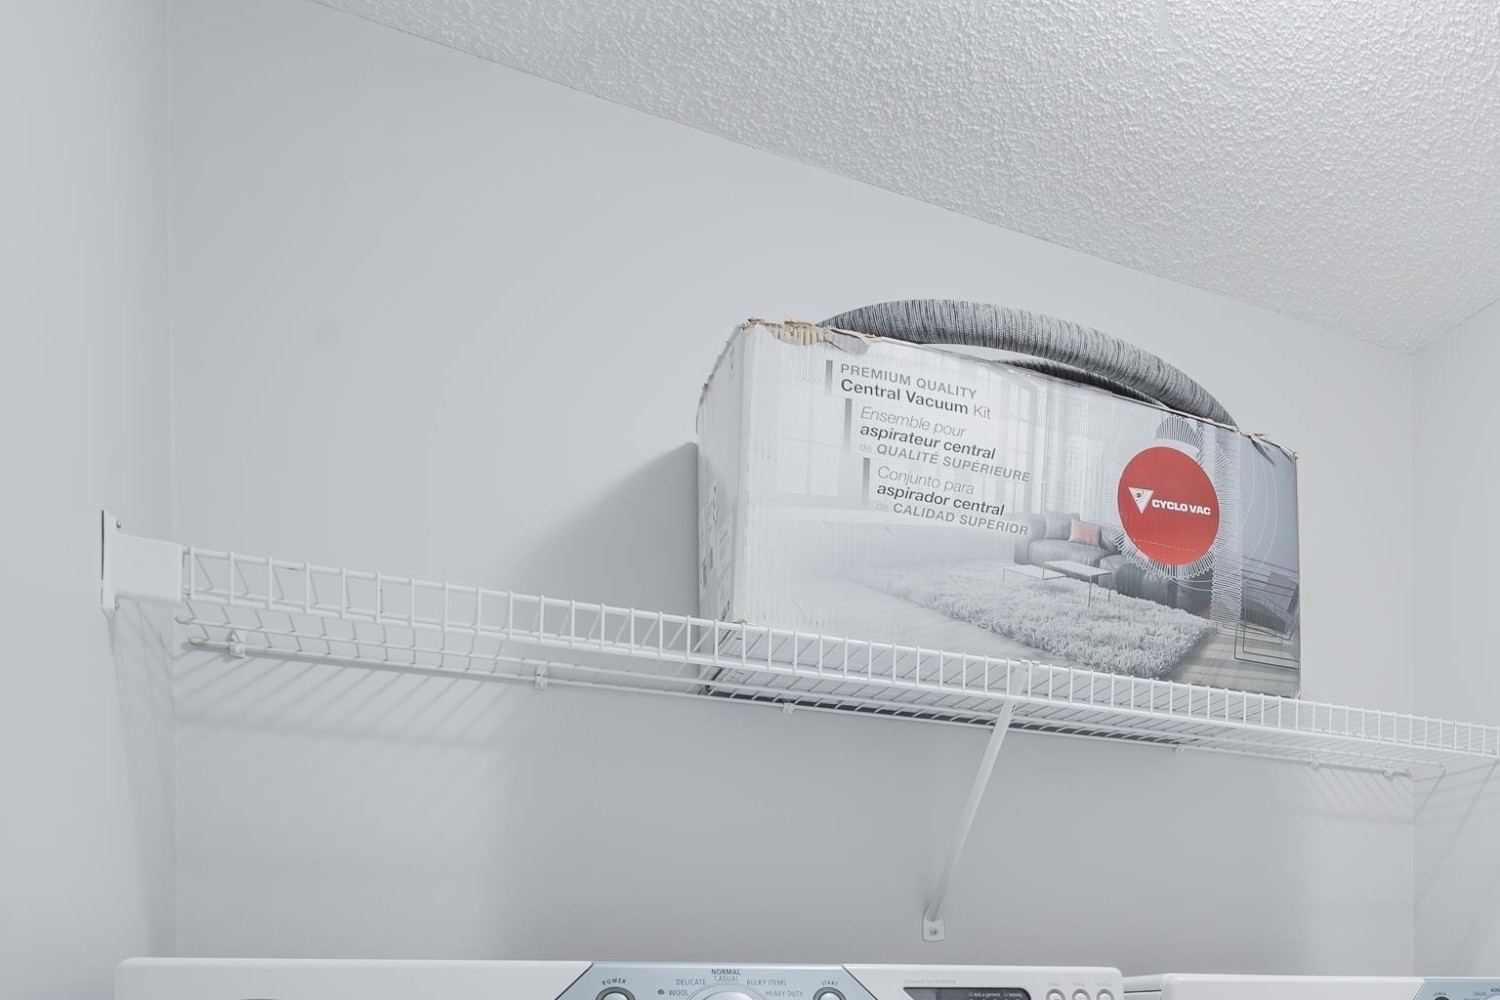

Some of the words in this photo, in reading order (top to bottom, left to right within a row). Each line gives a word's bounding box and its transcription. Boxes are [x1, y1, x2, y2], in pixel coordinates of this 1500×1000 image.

[840, 363, 911, 386] PREMIUM
[916, 377, 977, 399] QUALITY
[841, 378, 901, 401] Central
[905, 390, 969, 415] Vacuum
[973, 404, 991, 420] Kit
[860, 405, 931, 431] Ensemble
[933, 423, 968, 438] pour
[860, 424, 941, 449] aspirateur
[943, 440, 996, 460] central
[876, 443, 939, 465] QUALITÉ
[942, 455, 1031, 483] SUPÉRIEURE
[877, 465, 941, 489] Conjunto
[943, 480, 975, 496] para
[876, 484, 951, 506] aspirador
[953, 496, 1005, 516] central
[1151, 499, 1189, 512] CYCLO
[1189, 503, 1212, 516] VAC
[893, 502, 955, 523] CALIDAD
[959, 514, 1029, 536] SUPERIOR
[601, 978, 627, 986] POWER
[676, 978, 706, 986] DELICATE
[711, 968, 741, 976] NORMAL
[668, 989, 689, 997] WOOL
